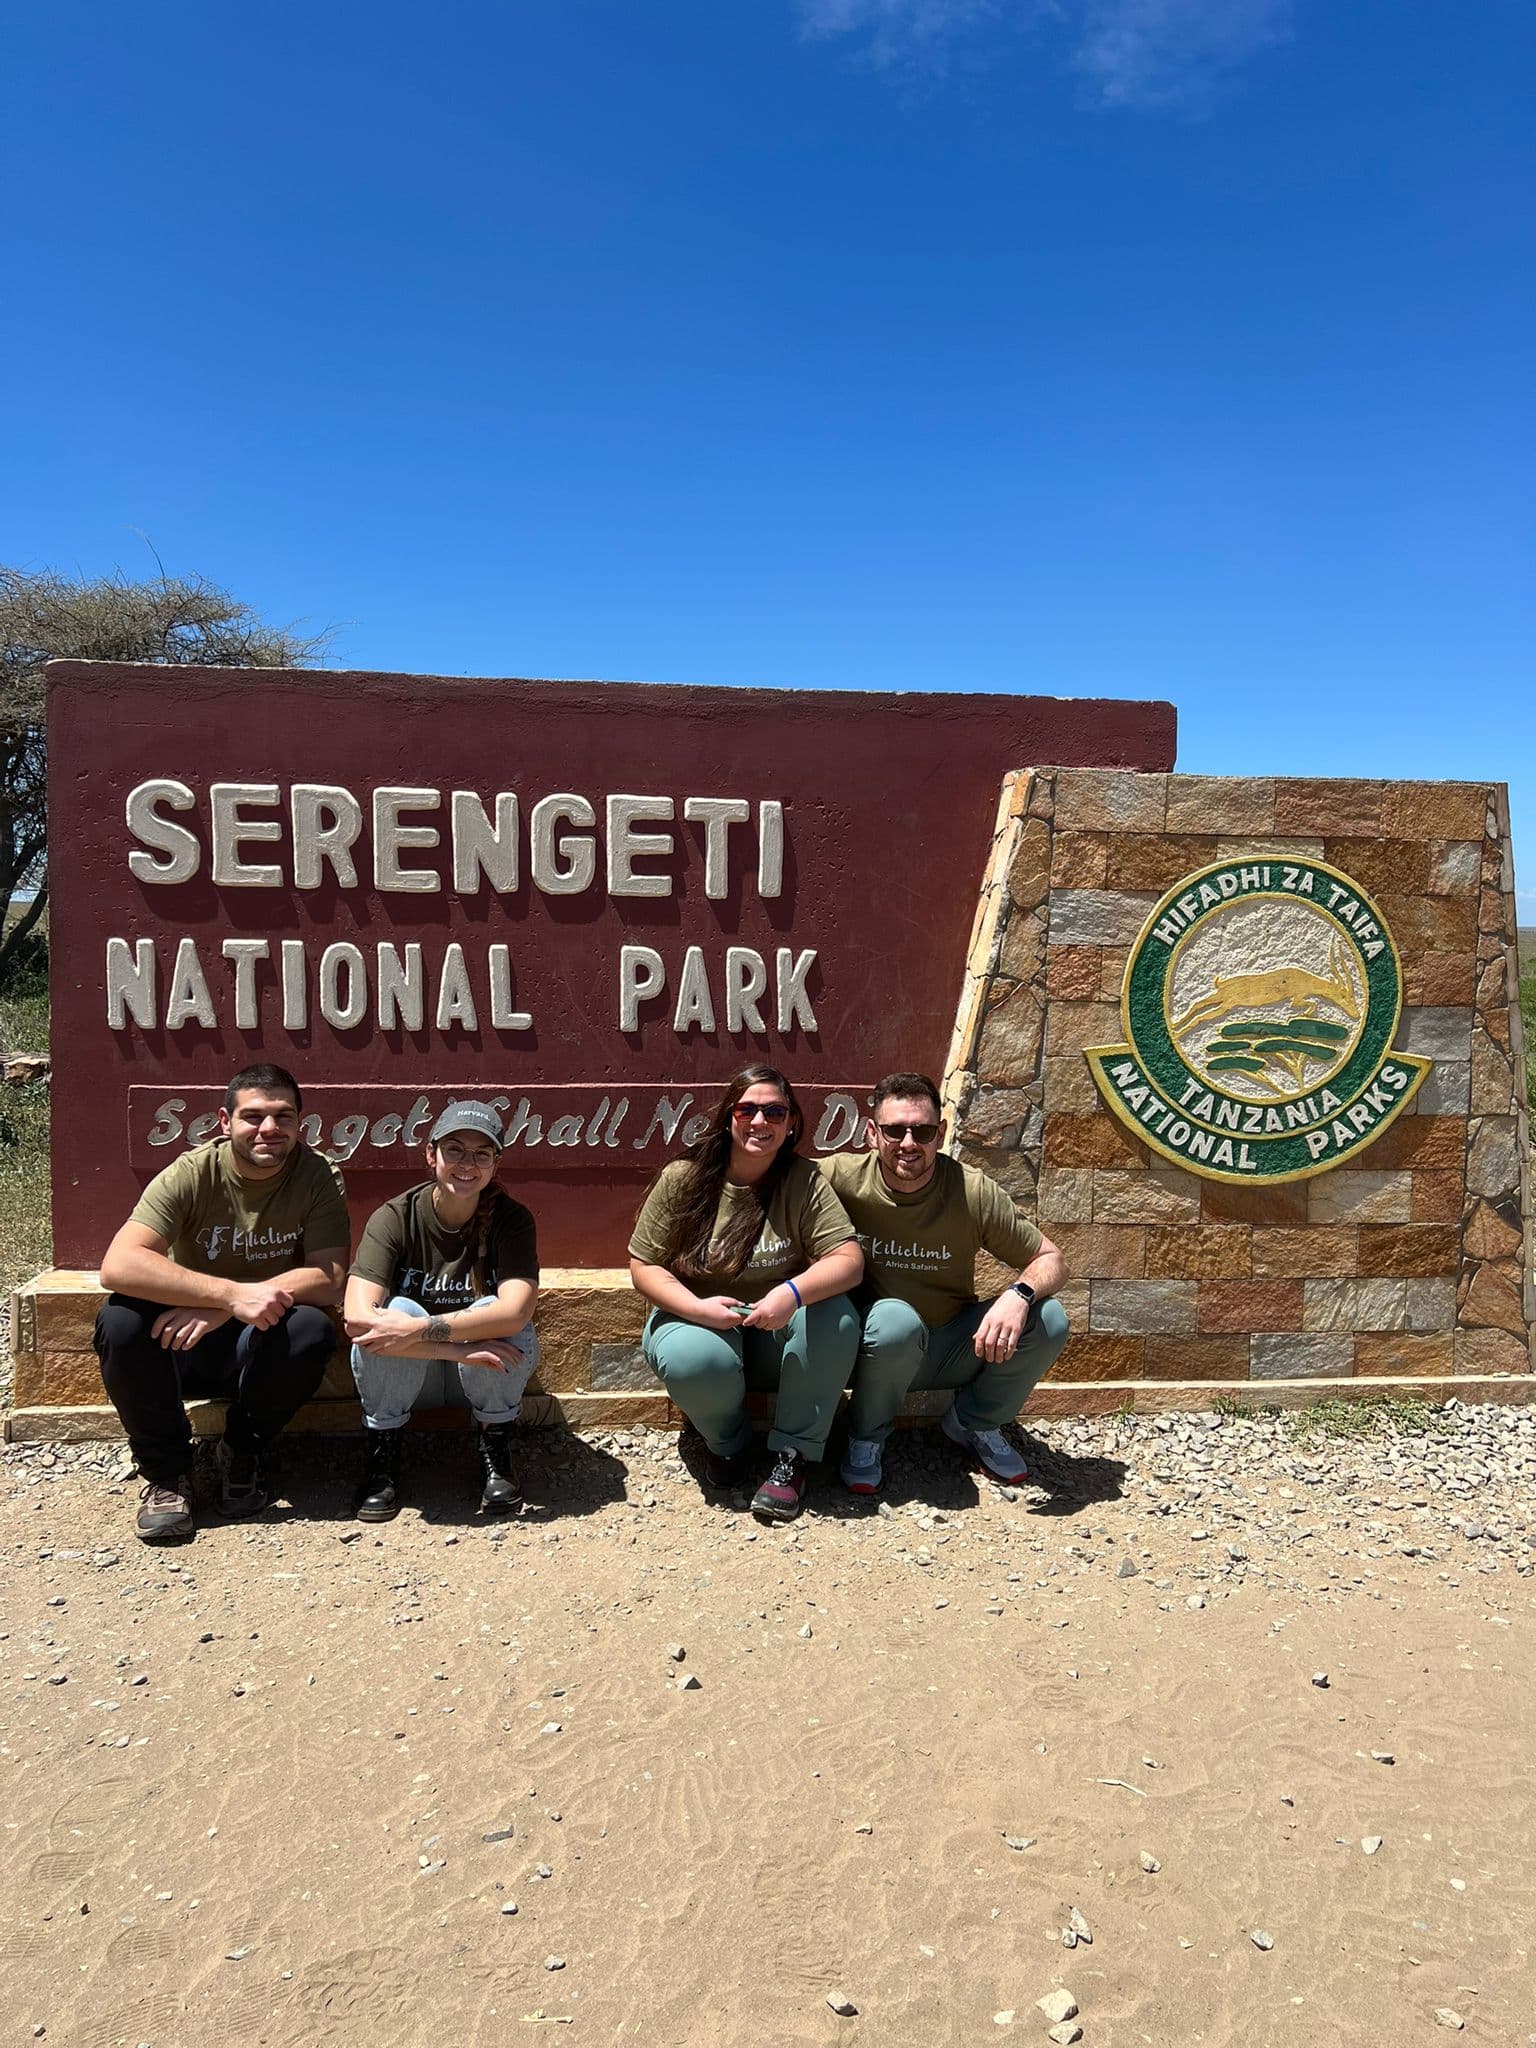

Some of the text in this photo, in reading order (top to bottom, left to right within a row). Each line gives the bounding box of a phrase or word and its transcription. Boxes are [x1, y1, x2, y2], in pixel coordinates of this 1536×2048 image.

[126, 779, 784, 899] SERENGETI
[1152, 866, 1386, 960] HIFADHI ZA TAIFA
[106, 938, 818, 1033] NATIONAL PARK
[147, 1096, 458, 1163] Senget
[813, 1092, 876, 1150] Di
[1110, 1062, 1409, 1170] NATIONAL PARKS
[1177, 1078, 1342, 1134] TANZANIA
[872, 1237, 952, 1260] Kiliclimb
[886, 1260, 938, 1271] Africa Safaris
[435, 1296, 461, 1304] Africa
